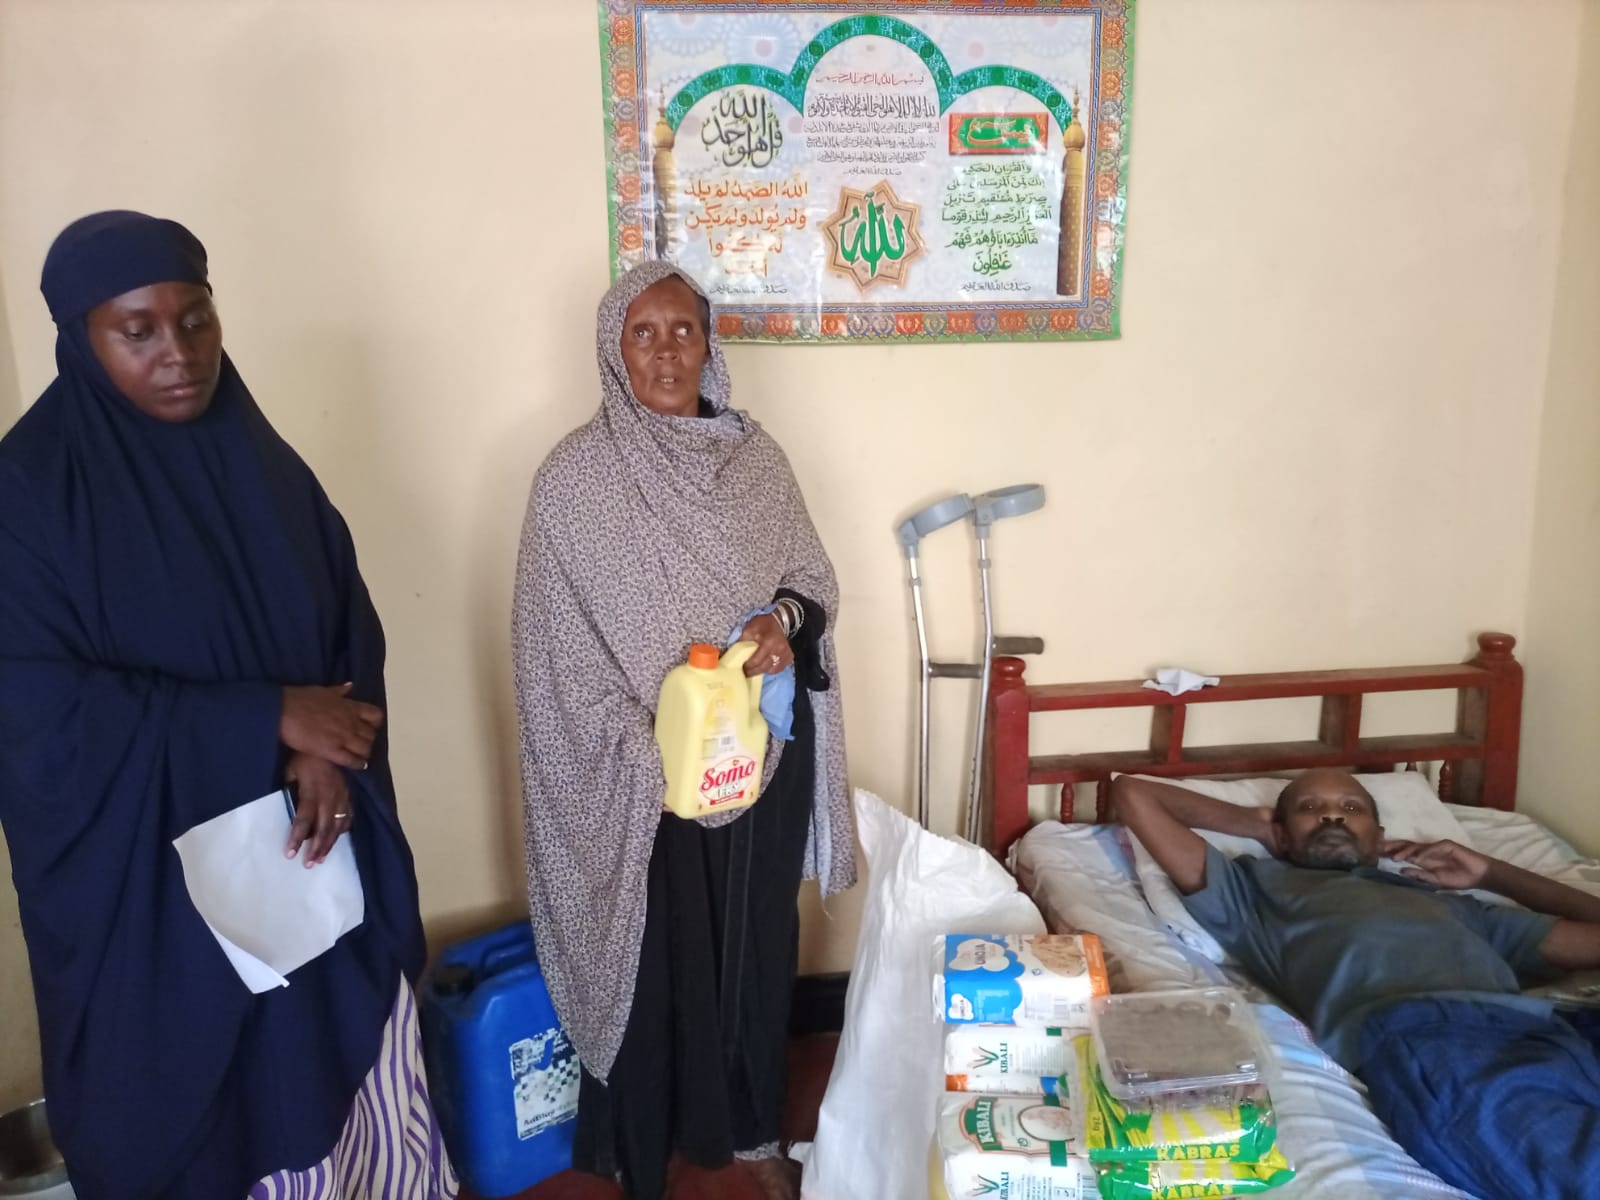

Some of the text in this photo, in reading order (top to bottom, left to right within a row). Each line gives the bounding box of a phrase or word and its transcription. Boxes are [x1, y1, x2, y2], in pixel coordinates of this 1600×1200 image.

[700, 760, 756, 791] Somo
[1000, 1042, 1008, 1074] KIBALI
[976, 1100, 995, 1145] KIBALI
[1157, 1143, 1240, 1161] KABRAS
[1000, 1171, 1009, 1200] IBALI
[1152, 1184, 1233, 1200] KABRAS
